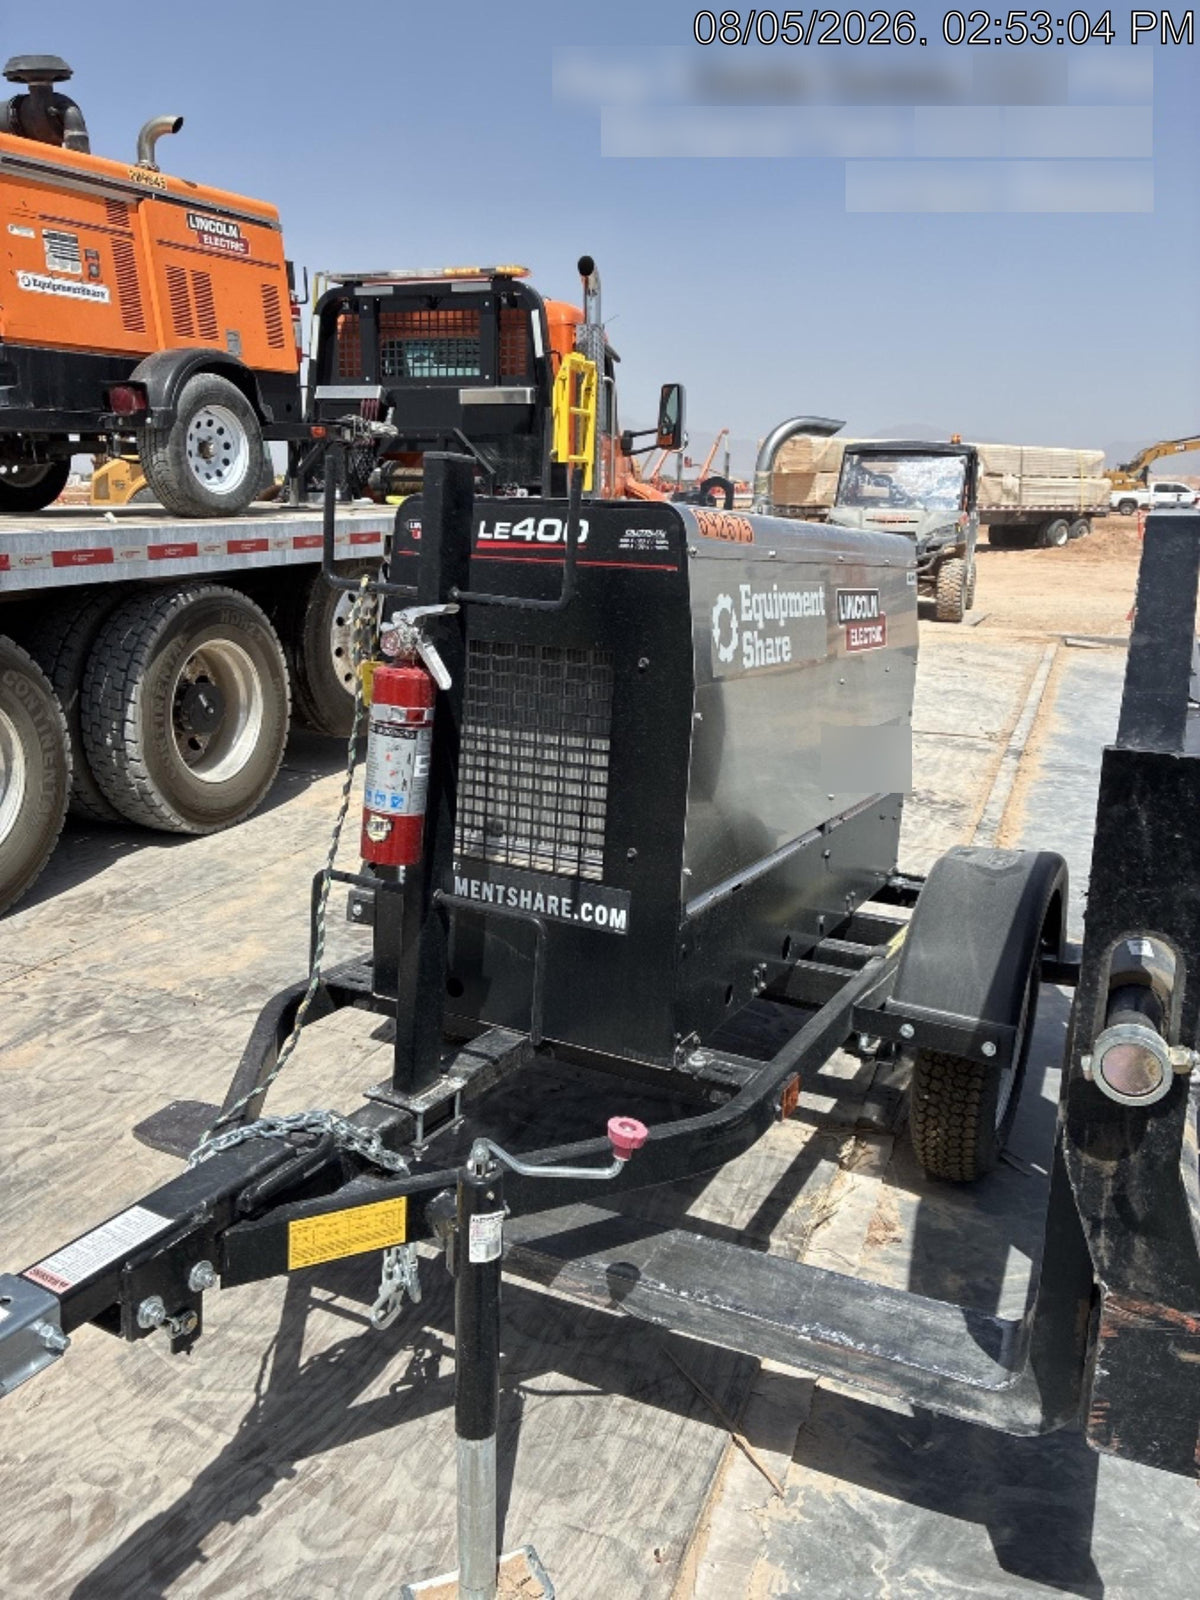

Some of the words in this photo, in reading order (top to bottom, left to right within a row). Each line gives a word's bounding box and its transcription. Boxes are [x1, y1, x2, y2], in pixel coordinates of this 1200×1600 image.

[190, 214, 239, 239] LINCOLN
[203, 233, 245, 252] ELECTRIC
[478, 517, 590, 543] LE400
[739, 584, 826, 630] Equipment
[839, 594, 879, 620] LINCOLN
[850, 625, 883, 646] ELECTRIC
[742, 631, 792, 669] Share
